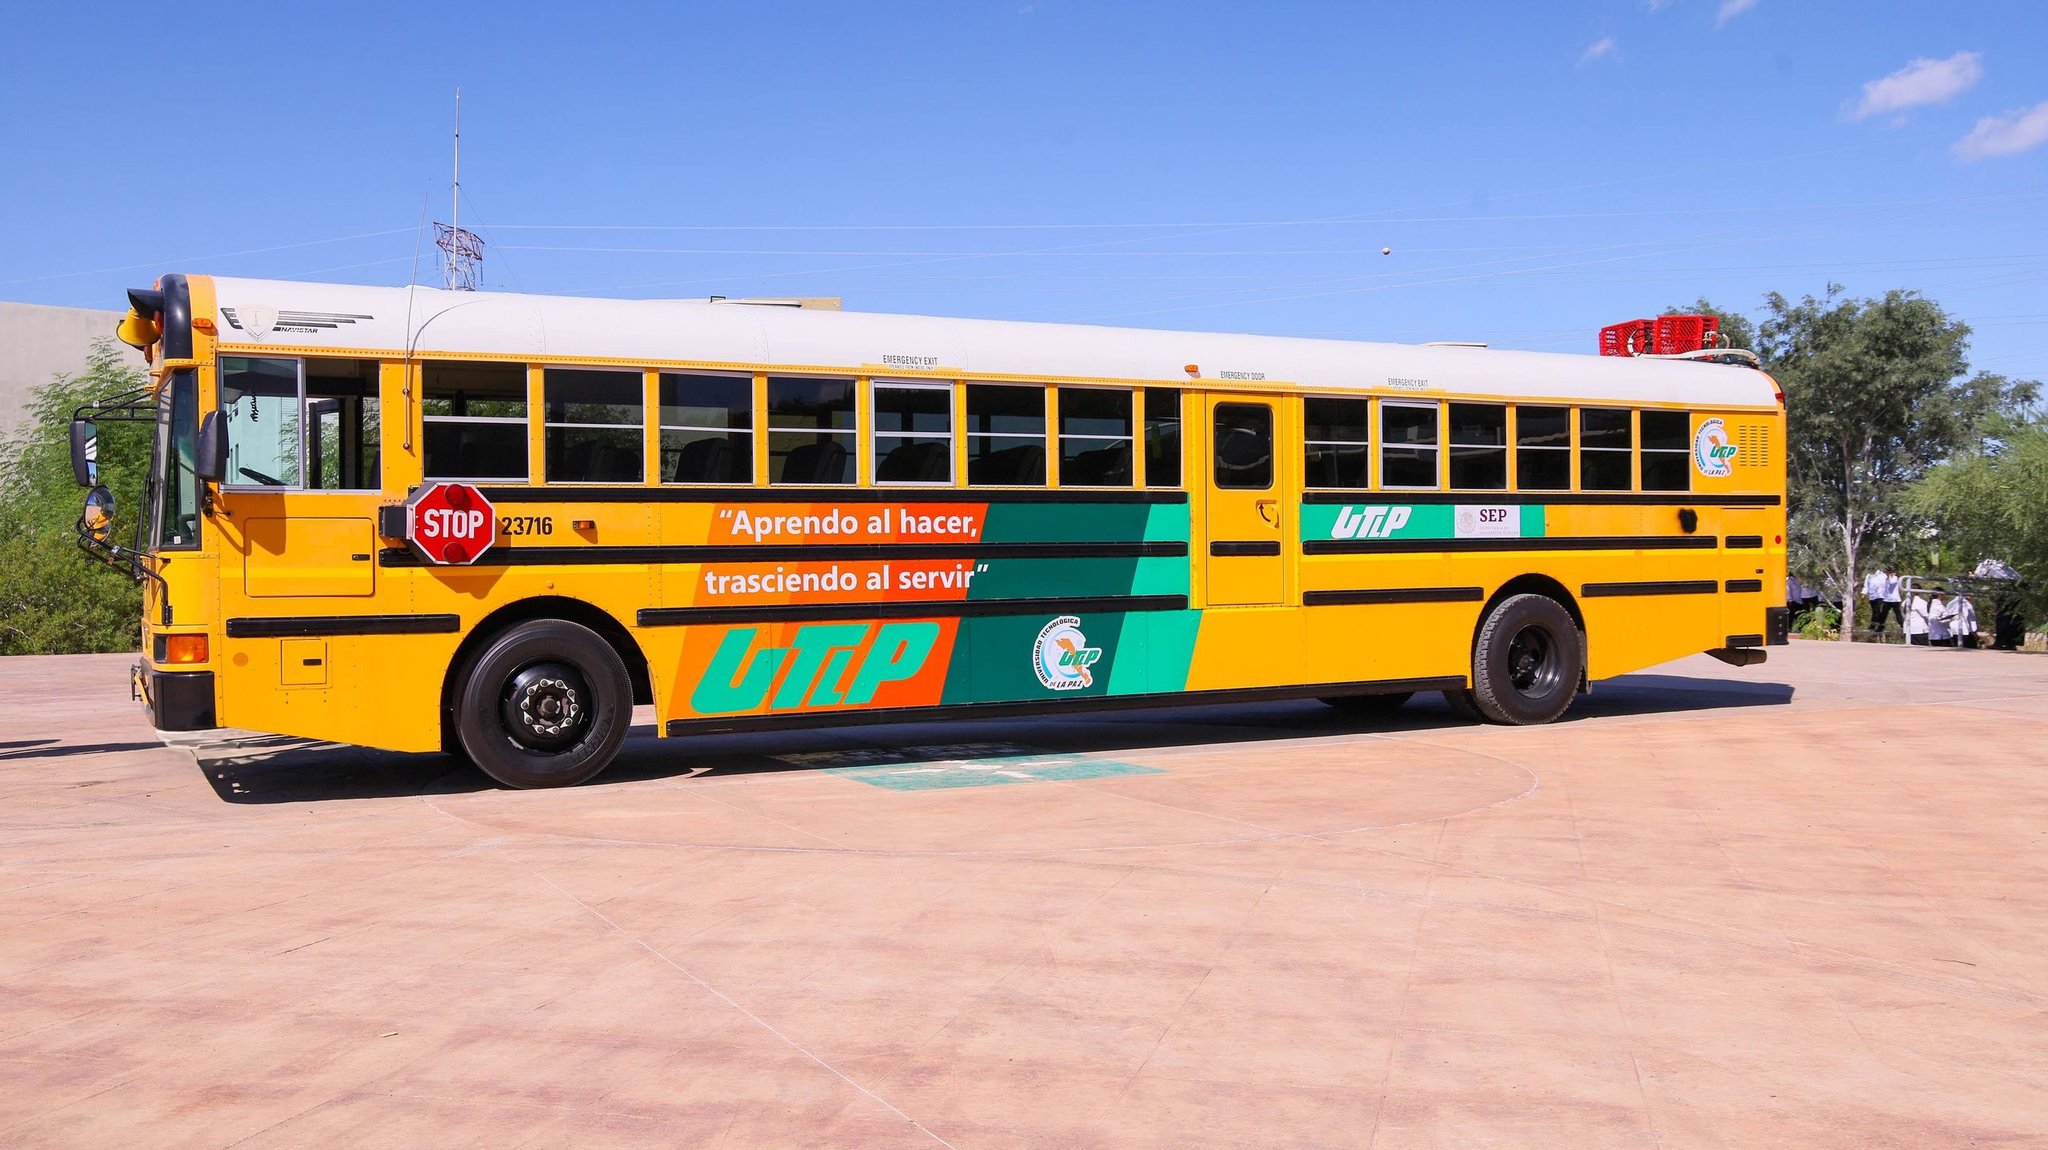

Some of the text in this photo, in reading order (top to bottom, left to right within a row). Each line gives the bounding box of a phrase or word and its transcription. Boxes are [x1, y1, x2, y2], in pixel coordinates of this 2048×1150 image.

[883, 355, 938, 366] EMERGENCY EXIT
[1220, 371, 1250, 380] EMERGENCY
[1388, 378, 1428, 388] EMERGENCY EXIT
[1479, 508, 1507, 522] SEP
[423, 508, 484, 539] STOP
[501, 517, 553, 535] 23716
[719, 508, 977, 542] “Aprendo al hacer,
[704, 563, 989, 594] trasciendo al servir”
[1034, 640, 1049, 684] UNIVERSIDAD
[1067, 680, 1083, 688] PAZ
